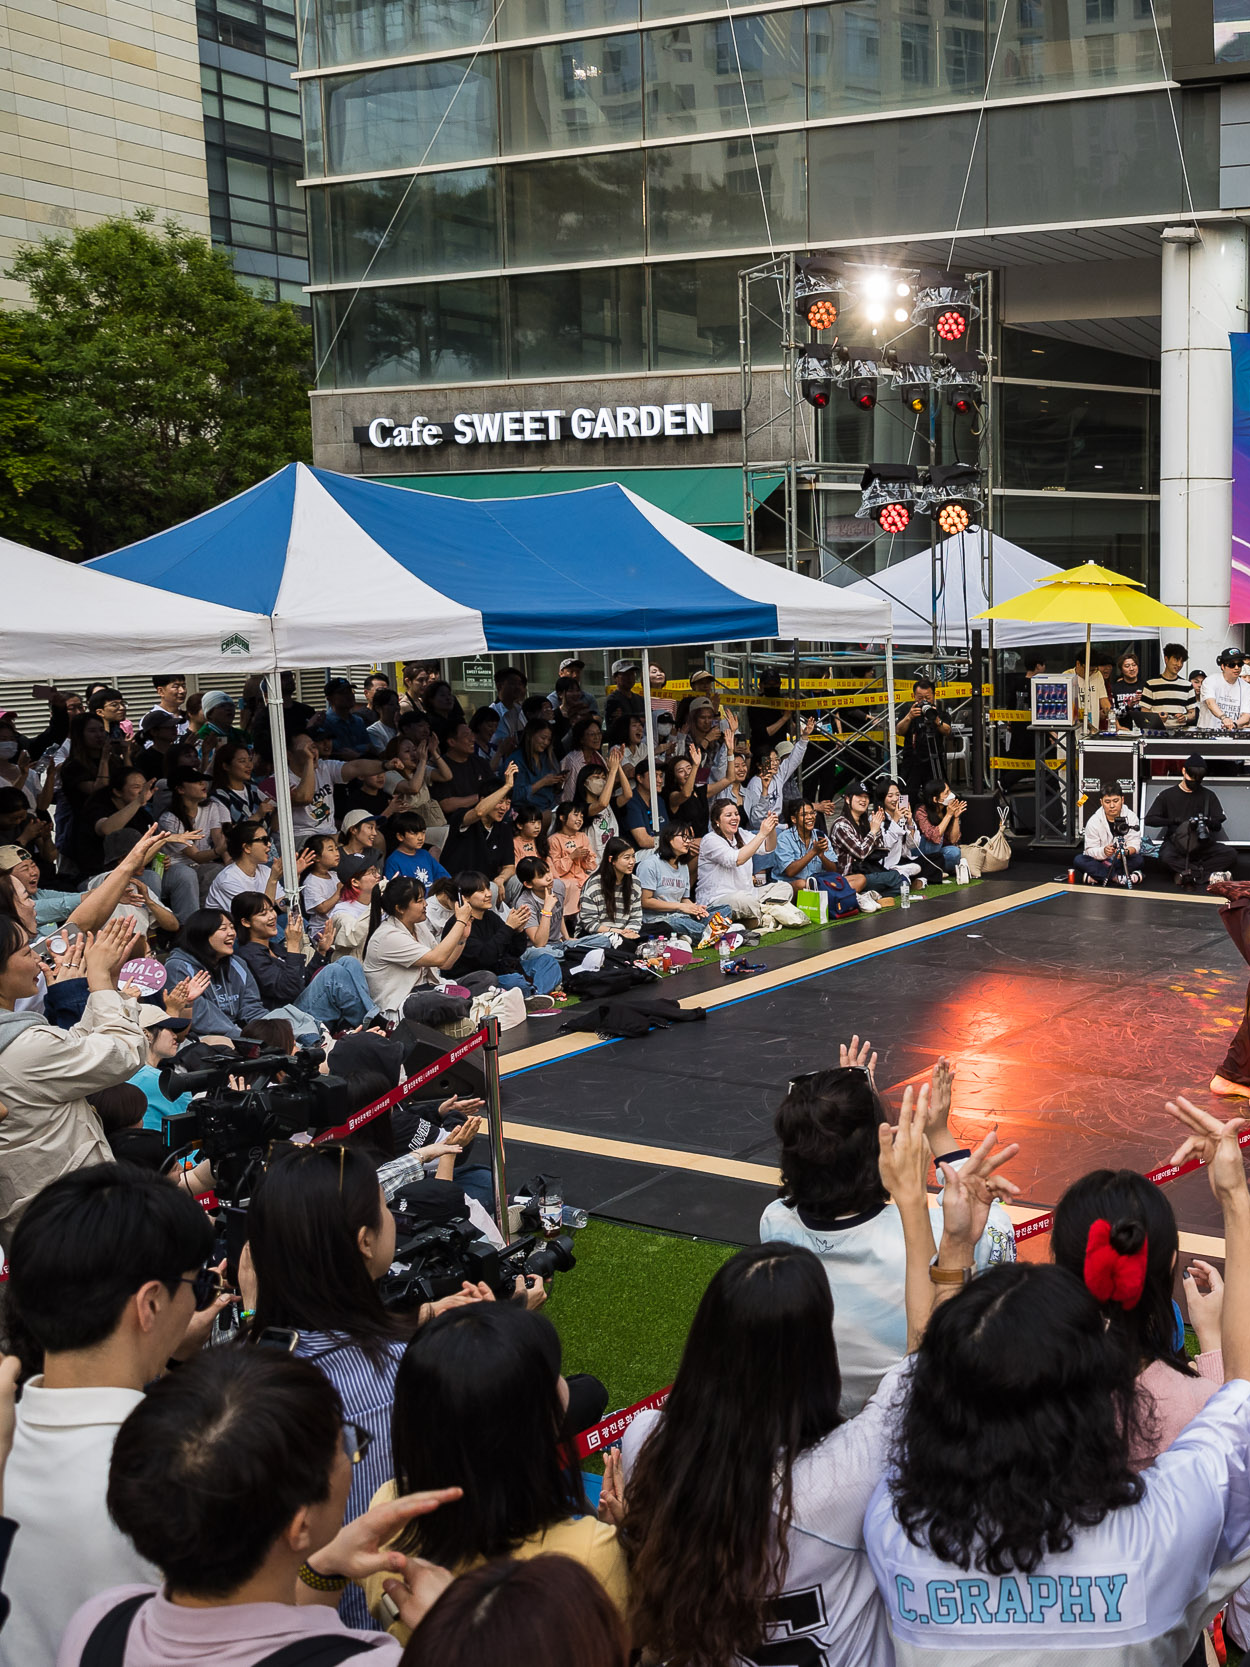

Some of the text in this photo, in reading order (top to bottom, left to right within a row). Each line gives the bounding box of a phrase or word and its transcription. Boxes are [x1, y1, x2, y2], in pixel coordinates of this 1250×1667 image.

[369, 402, 714, 448] Cafe SWEET GARDEN
[1015, 1218, 1050, 1238] 광진문화재단
[895, 1573, 1128, 1626] C.GRAPHY
